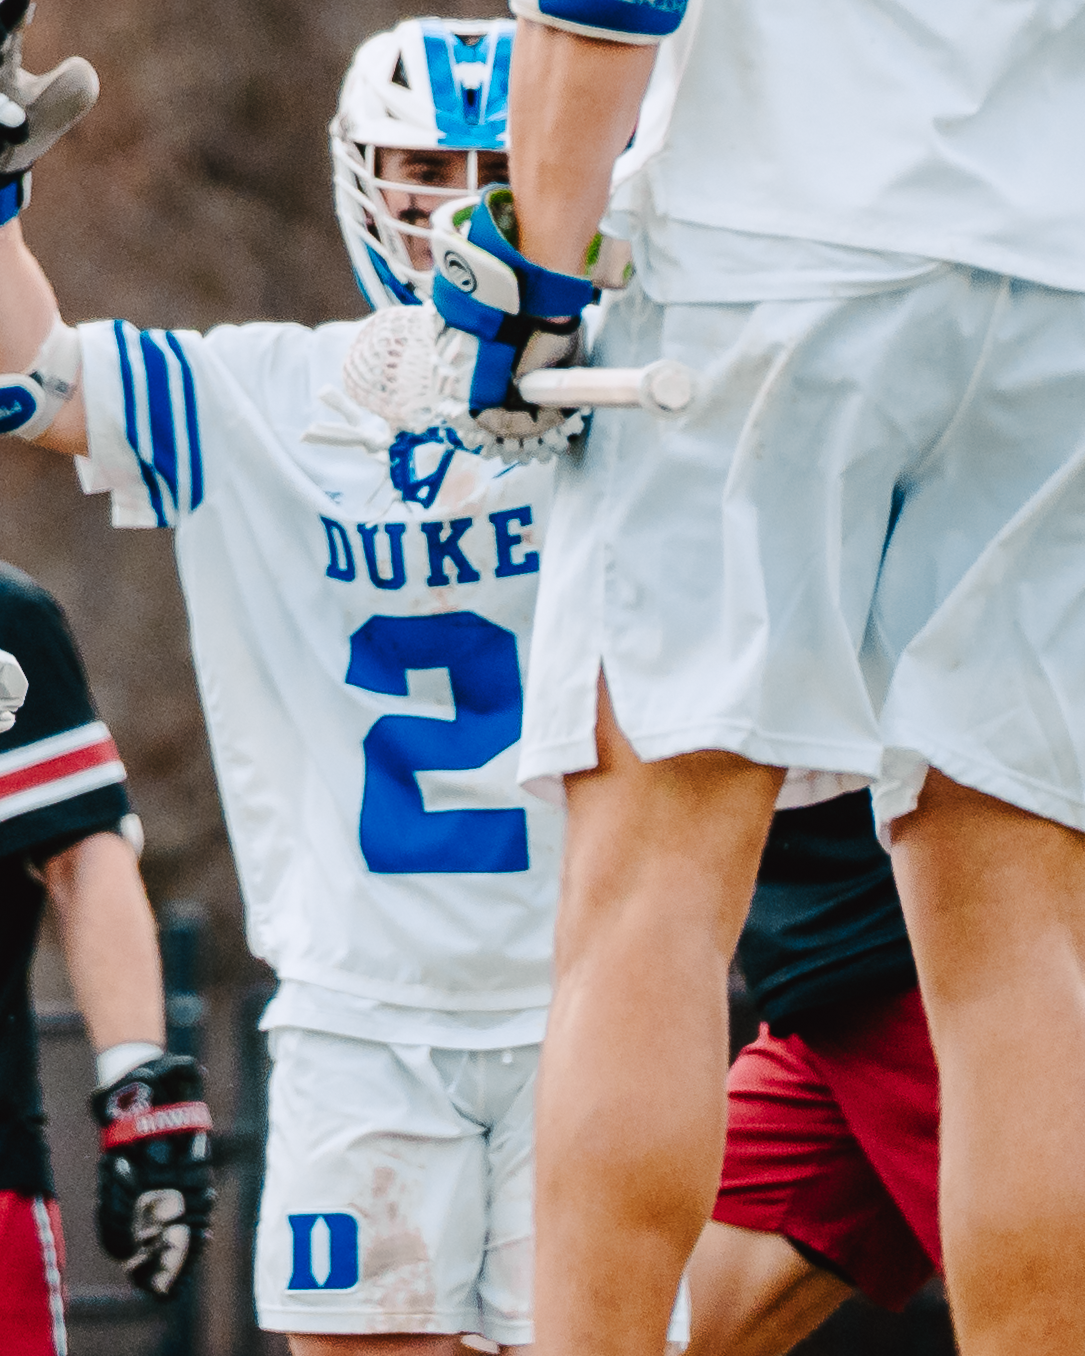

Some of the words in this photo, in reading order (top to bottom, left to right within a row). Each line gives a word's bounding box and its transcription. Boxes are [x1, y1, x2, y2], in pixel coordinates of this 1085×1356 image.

[320, 505, 541, 590] DUKE
[345, 610, 530, 874] 2
[287, 1212, 360, 1291] D
